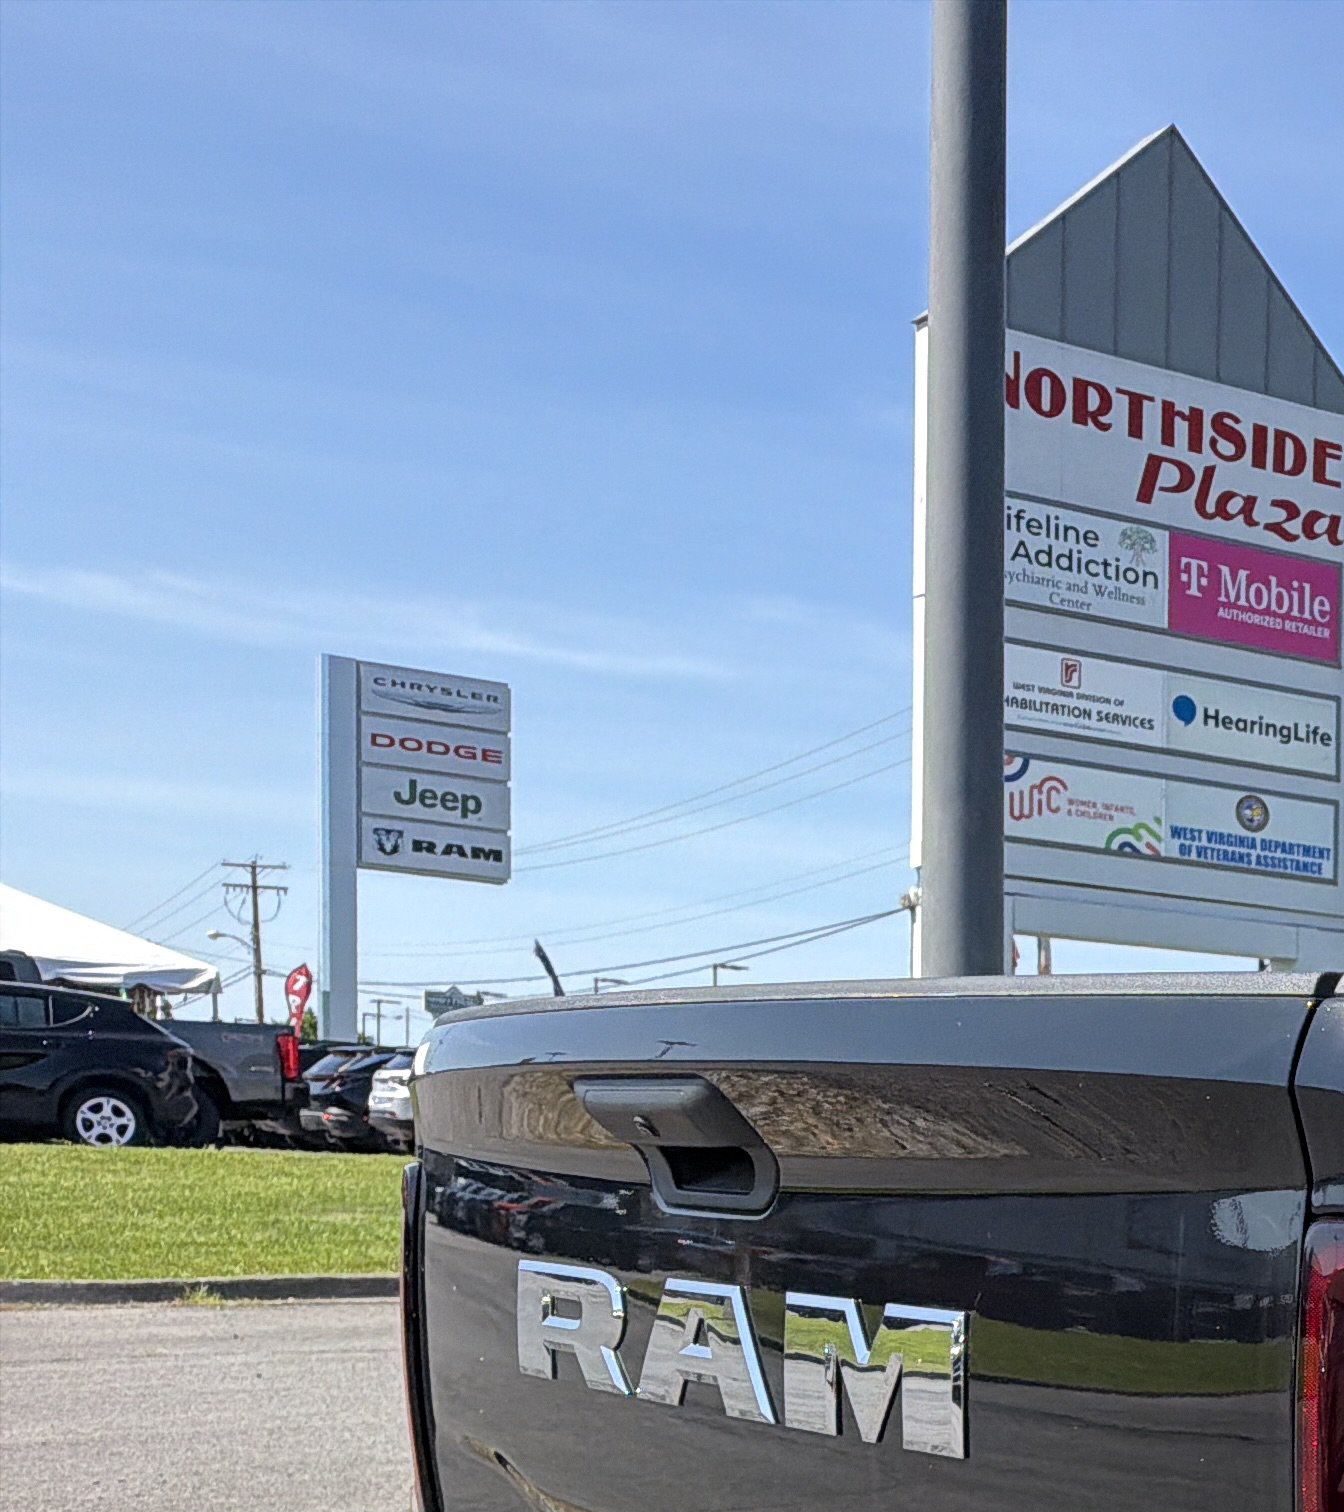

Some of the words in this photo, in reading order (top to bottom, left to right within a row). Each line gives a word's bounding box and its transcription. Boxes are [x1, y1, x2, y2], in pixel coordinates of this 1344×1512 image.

[1136, 453, 1344, 546] Plaza
[1010, 540, 1159, 590] Addiction
[1049, 592, 1093, 612] Center
[1065, 581, 1089, 595] and
[1092, 583, 1146, 606] Wellness
[1217, 564, 1331, 623] Mobile
[1217, 606, 1283, 630] AUTHORIZED
[1284, 619, 1331, 639] RETAILER
[373, 677, 499, 704] CHRYSLER
[1012, 681, 1036, 693] WEST
[1095, 710, 1156, 732] SERVICES
[1202, 707, 1333, 748] HearingLife
[370, 732, 503, 765] DODGE
[393, 778, 483, 819] Jeep
[411, 839, 503, 863] RAM
[1169, 825, 1202, 843] WEST
[1206, 830, 1257, 850] VIRGINIA
[1260, 837, 1331, 861] DEPARTMENT
[1179, 843, 1193, 857] OF
[1195, 845, 1253, 867] VETERANS
[1255, 853, 1323, 876] ASSISTANCE
[517, 1260, 970, 1460] RAM
